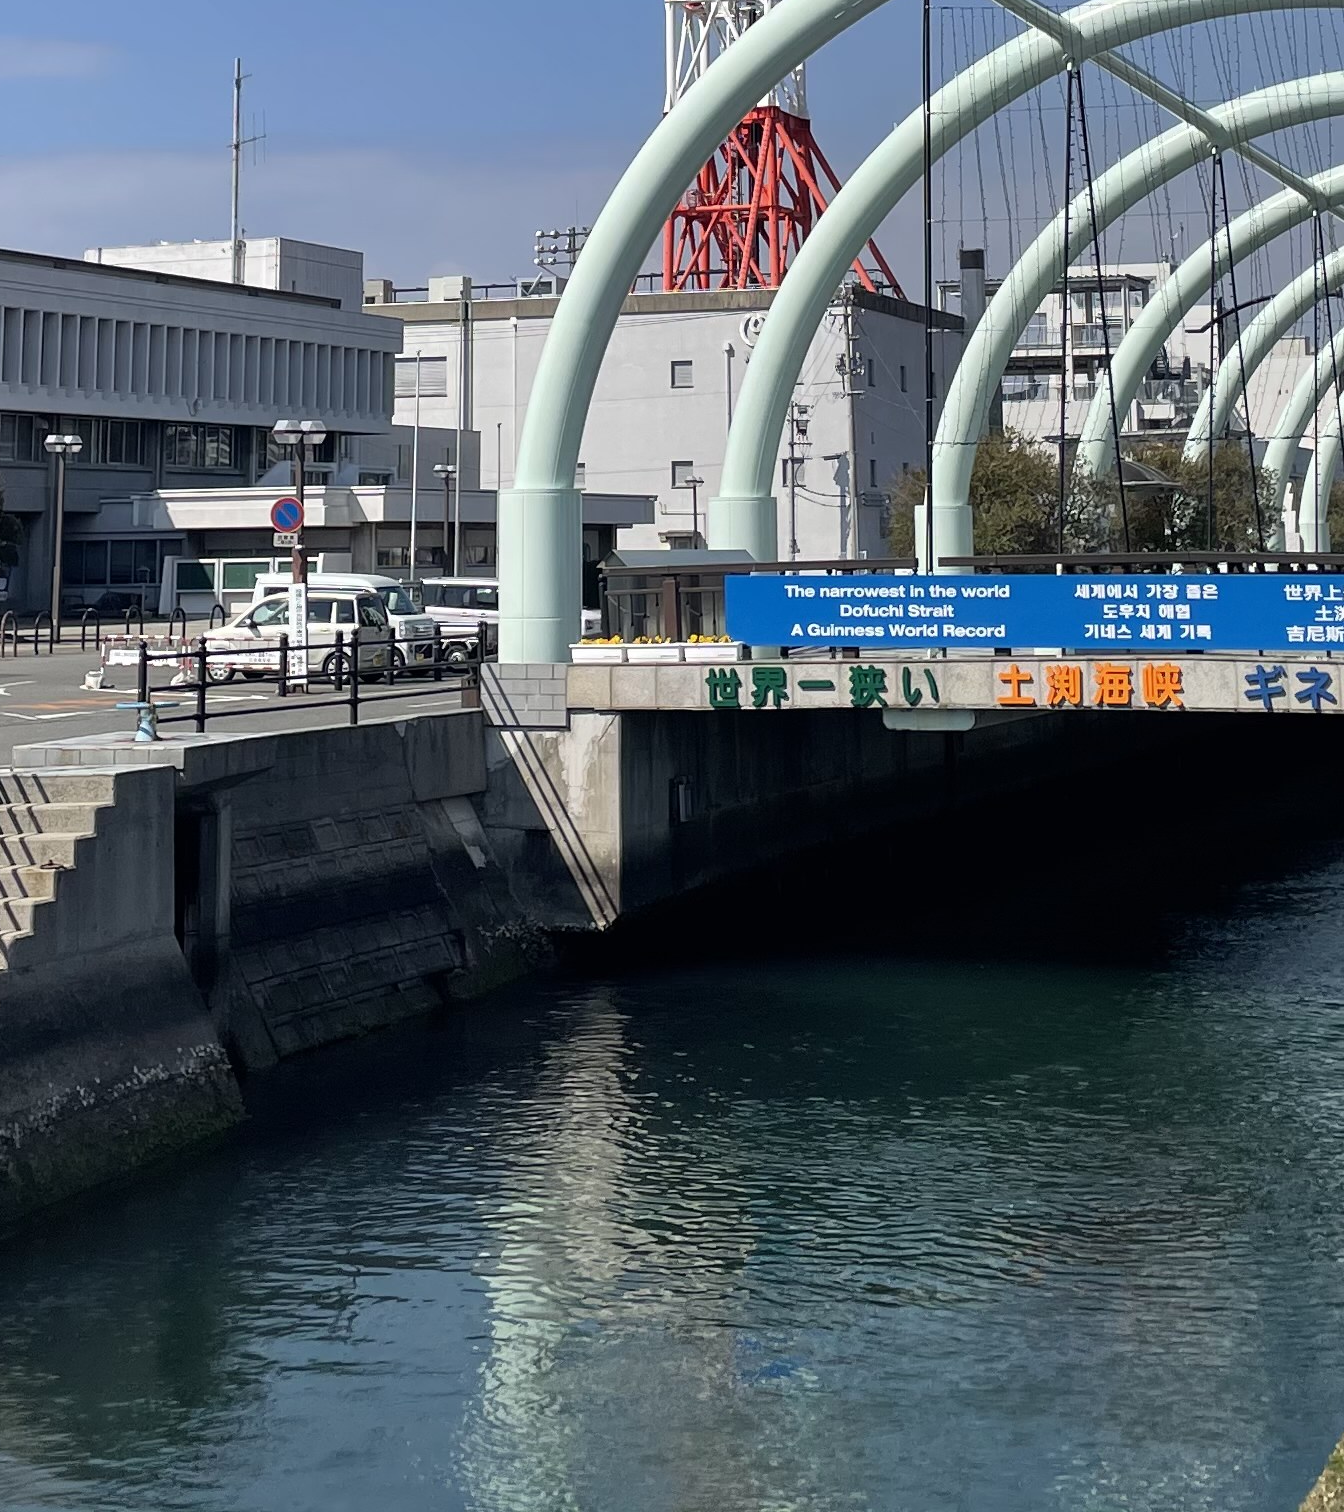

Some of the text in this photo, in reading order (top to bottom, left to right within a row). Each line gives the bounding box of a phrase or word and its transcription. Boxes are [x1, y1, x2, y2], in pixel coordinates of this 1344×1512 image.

[783, 584, 1010, 598] The narrowest in the world
[1074, 583, 1138, 600] 세계에서
[1145, 583, 1179, 600] 가장
[839, 603, 955, 618] Dofuchi Strait
[1102, 603, 1191, 620] 도후치 해협
[790, 623, 1006, 638] A Guinness World Record
[1084, 623, 1212, 640] 기네스 세계 기록
[705, 665, 941, 708] 世界一狭い
[996, 663, 1184, 709] 土渕海峡
